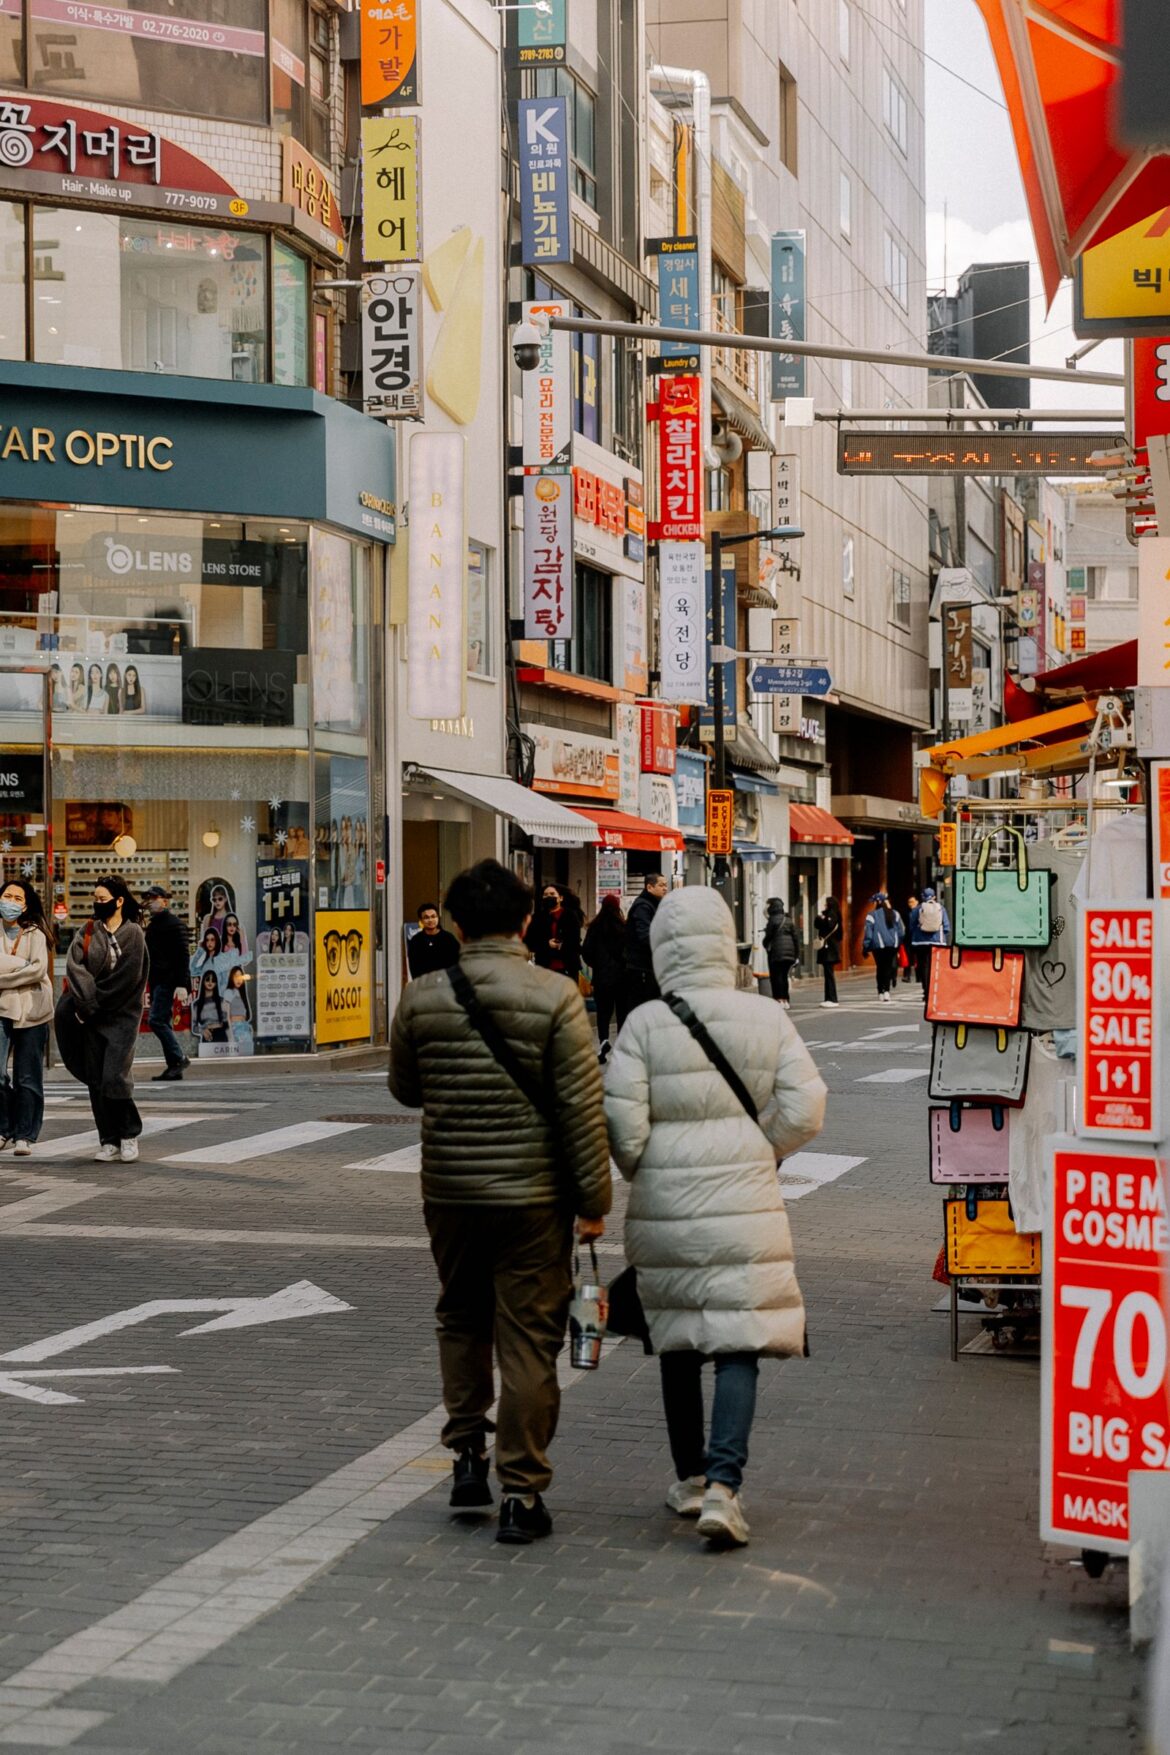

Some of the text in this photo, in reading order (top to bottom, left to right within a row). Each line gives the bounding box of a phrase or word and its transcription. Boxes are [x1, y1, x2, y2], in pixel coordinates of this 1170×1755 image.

[142, 19, 210, 41] 02.776-2020
[378, 25, 403, 81] 가발
[400, 86, 413, 96] 4F
[526, 107, 560, 144] K
[530, 143, 558, 156] 의원
[62, 179, 132, 201] Hair Make up
[164, 192, 217, 211] 777-9079
[232, 201, 245, 214] 3F
[291, 162, 331, 228] 미용실
[376, 166, 406, 251] 헤어
[532, 171, 560, 257] 비뇨기과
[661, 241, 696, 253] Dry cleaner
[368, 296, 413, 391] 안경
[663, 358, 688, 368] Laundry
[539, 378, 554, 408] 요리
[0, 425, 174, 471] AR OPTIC
[539, 413, 554, 458] 전문점
[557, 453, 570, 464] 2F
[538, 504, 559, 544] 원당
[662, 523, 700, 537] CHICKEN
[202, 563, 261, 577] LENS STORE
[429, 492, 443, 660] BANANA
[532, 545, 565, 636] 감자탕
[674, 597, 692, 671] 육전당
[262, 887, 301, 922] 1+1
[1090, 917, 1152, 948] SALE
[325, 985, 362, 1012] MOSCOT
[1091, 961, 1151, 1002] 80%
[1090, 1015, 1151, 1047] SALE
[1096, 1059, 1141, 1095] 1+1
[1060, 1284, 1167, 1397] 70
[1068, 1411, 1130, 1462] BIG
[1063, 1493, 1128, 1529] MASK
